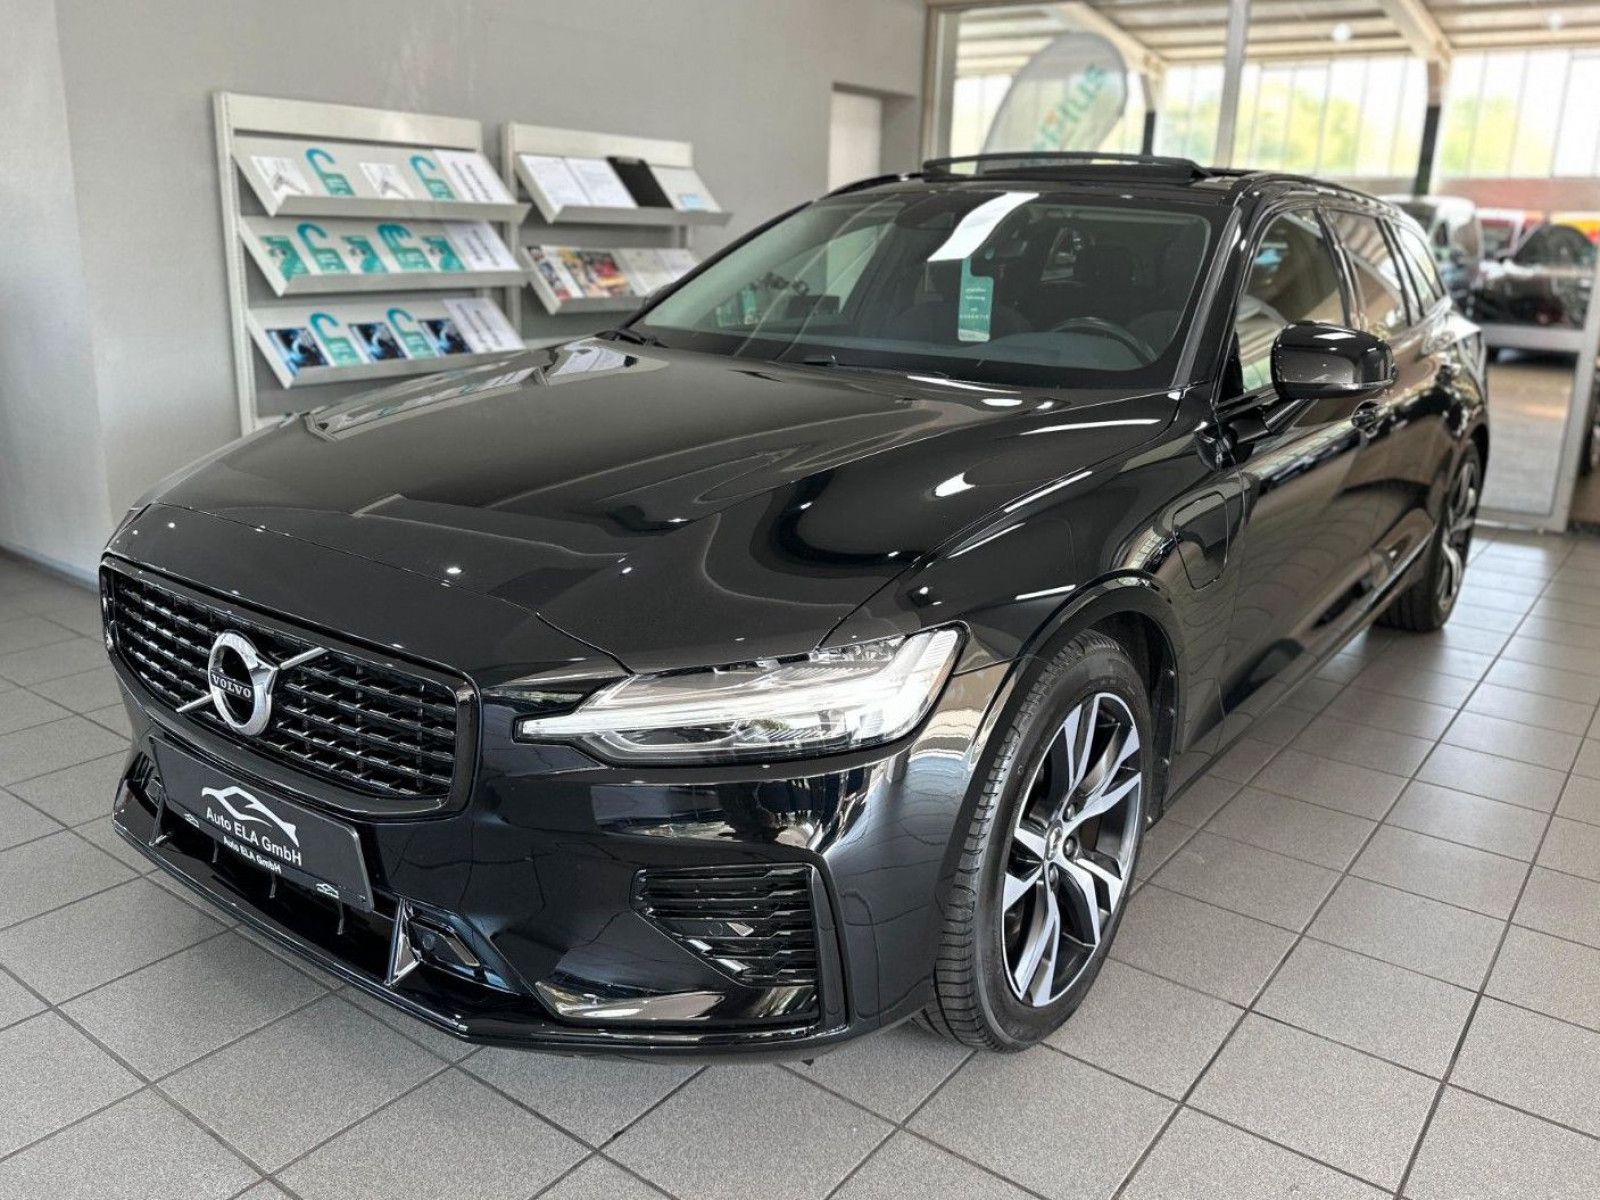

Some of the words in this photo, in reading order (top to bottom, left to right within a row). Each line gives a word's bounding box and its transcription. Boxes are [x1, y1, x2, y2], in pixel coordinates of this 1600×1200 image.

[212, 674, 252, 698] VOLVO
[206, 807, 232, 831] Auto
[233, 821, 260, 846] ELA
[261, 836, 302, 867] GmbH
[223, 836, 239, 852] Auto
[239, 845, 256, 862] ELA
[256, 855, 282, 874] GmbH
